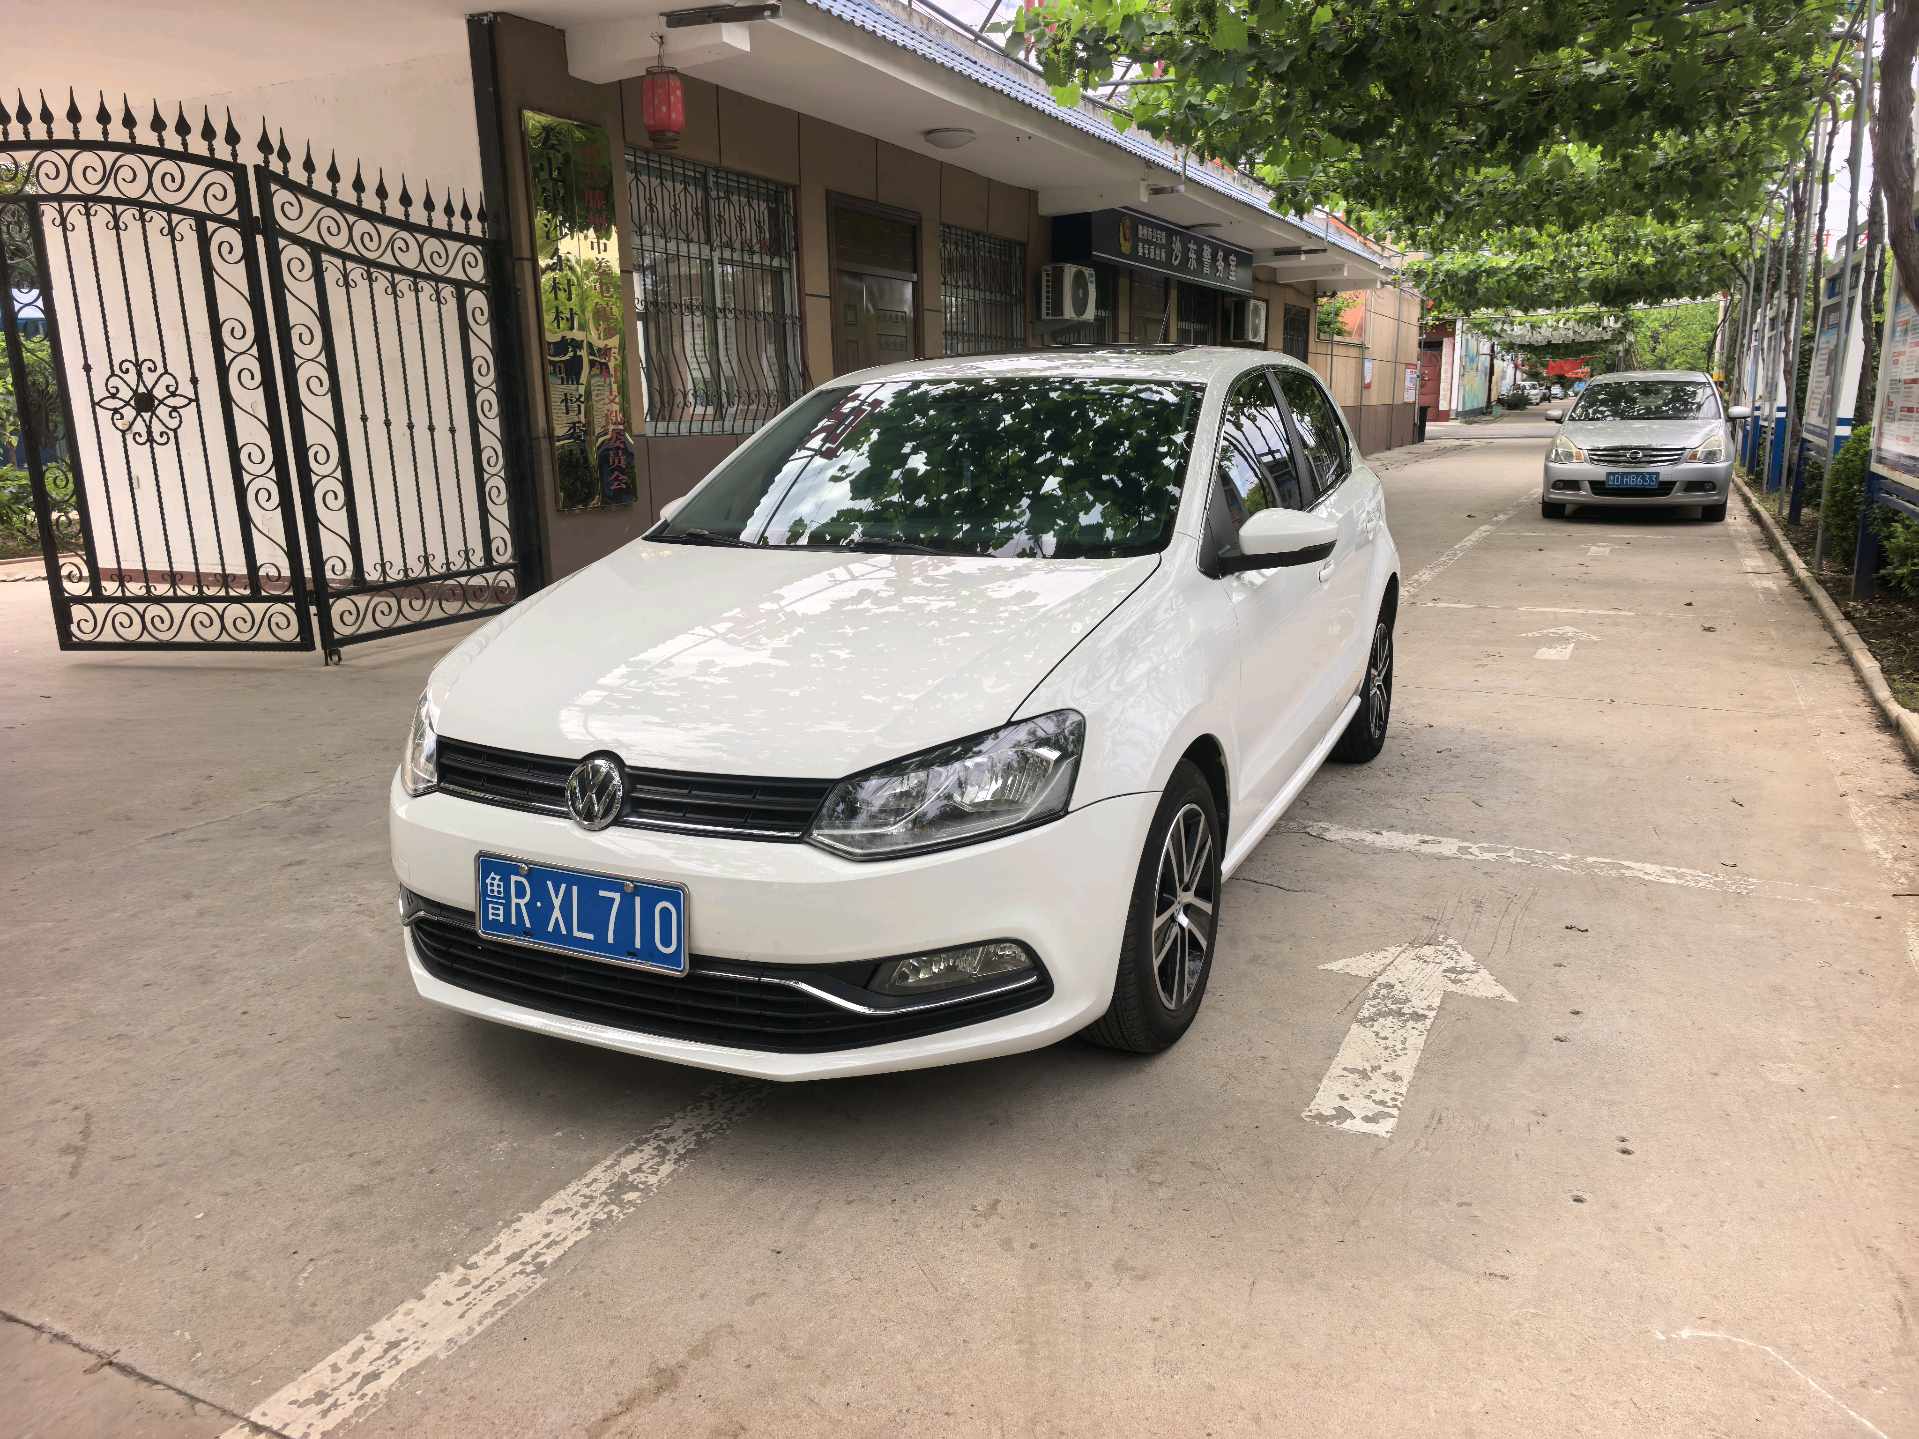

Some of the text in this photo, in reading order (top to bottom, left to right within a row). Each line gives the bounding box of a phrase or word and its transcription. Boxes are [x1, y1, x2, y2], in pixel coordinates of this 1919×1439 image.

[1171, 234, 1238, 281] 沙东警务室
[485, 871, 678, 955] 鲁R·XL710
